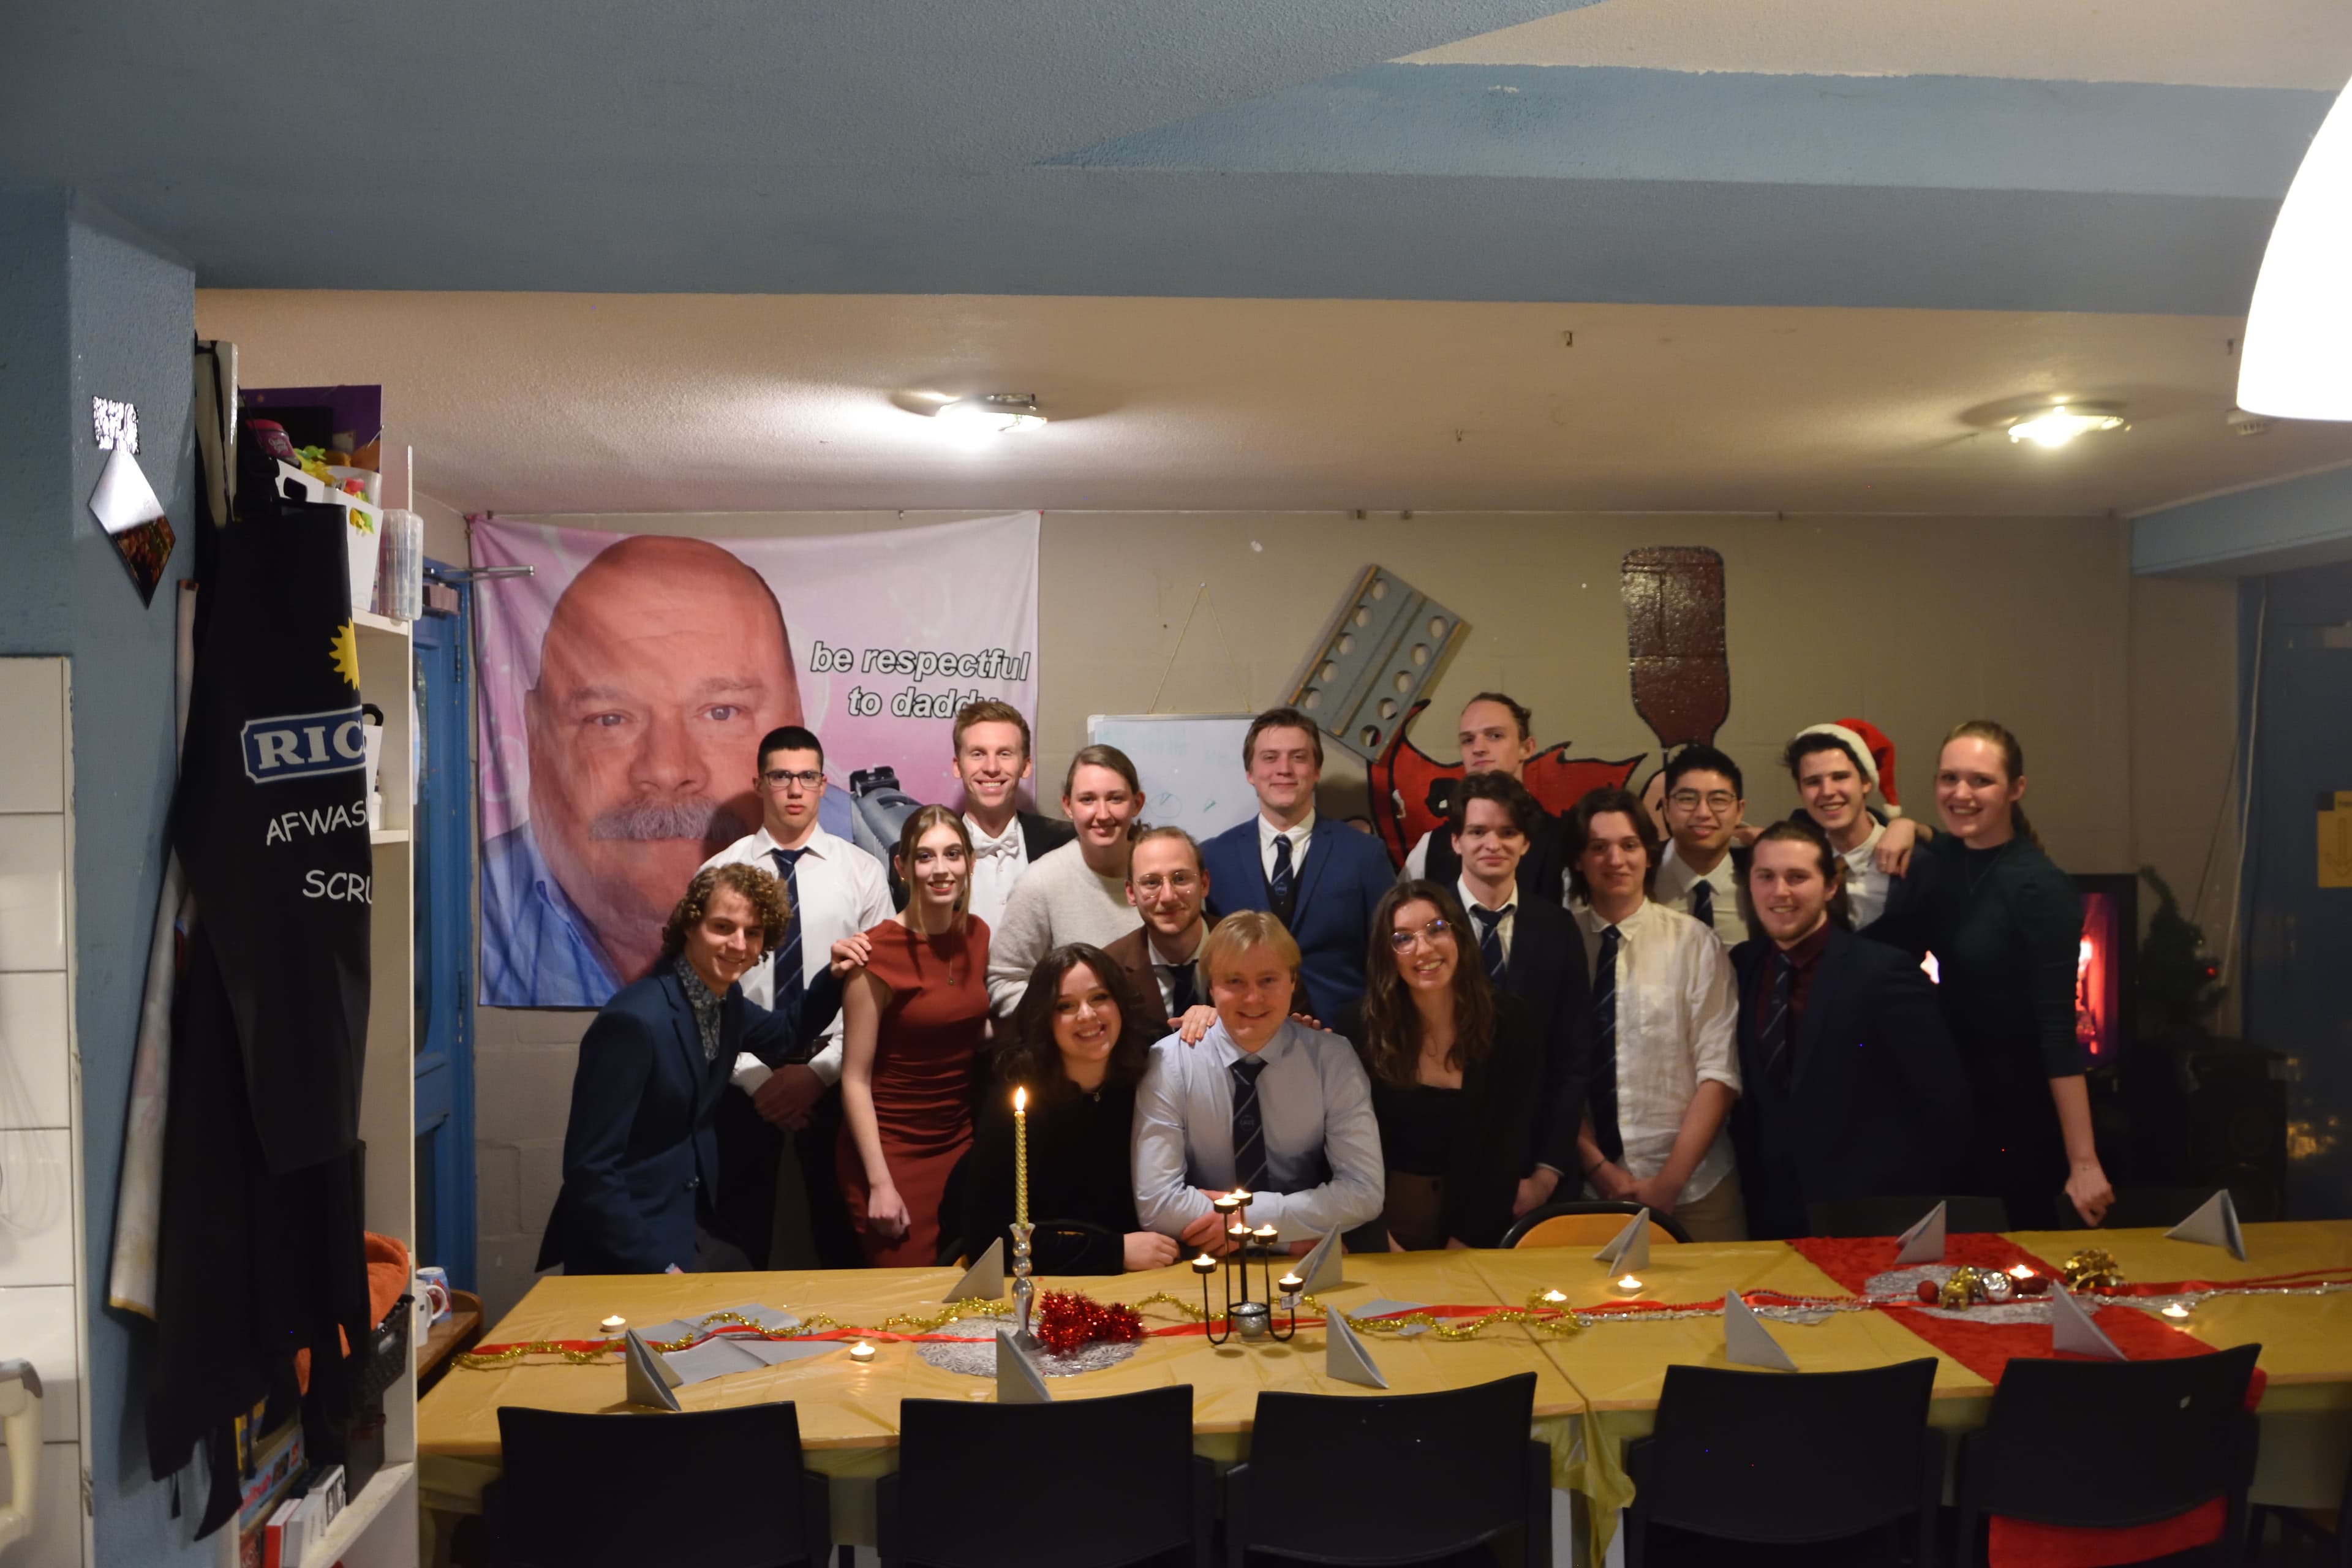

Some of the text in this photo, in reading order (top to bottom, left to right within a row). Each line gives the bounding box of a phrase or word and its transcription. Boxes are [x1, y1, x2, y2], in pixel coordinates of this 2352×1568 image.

[810, 641, 1031, 681] be respectful
[848, 686, 999, 718] to dadd
[254, 720, 364, 769] RIC
[266, 797, 368, 846] AFWAS
